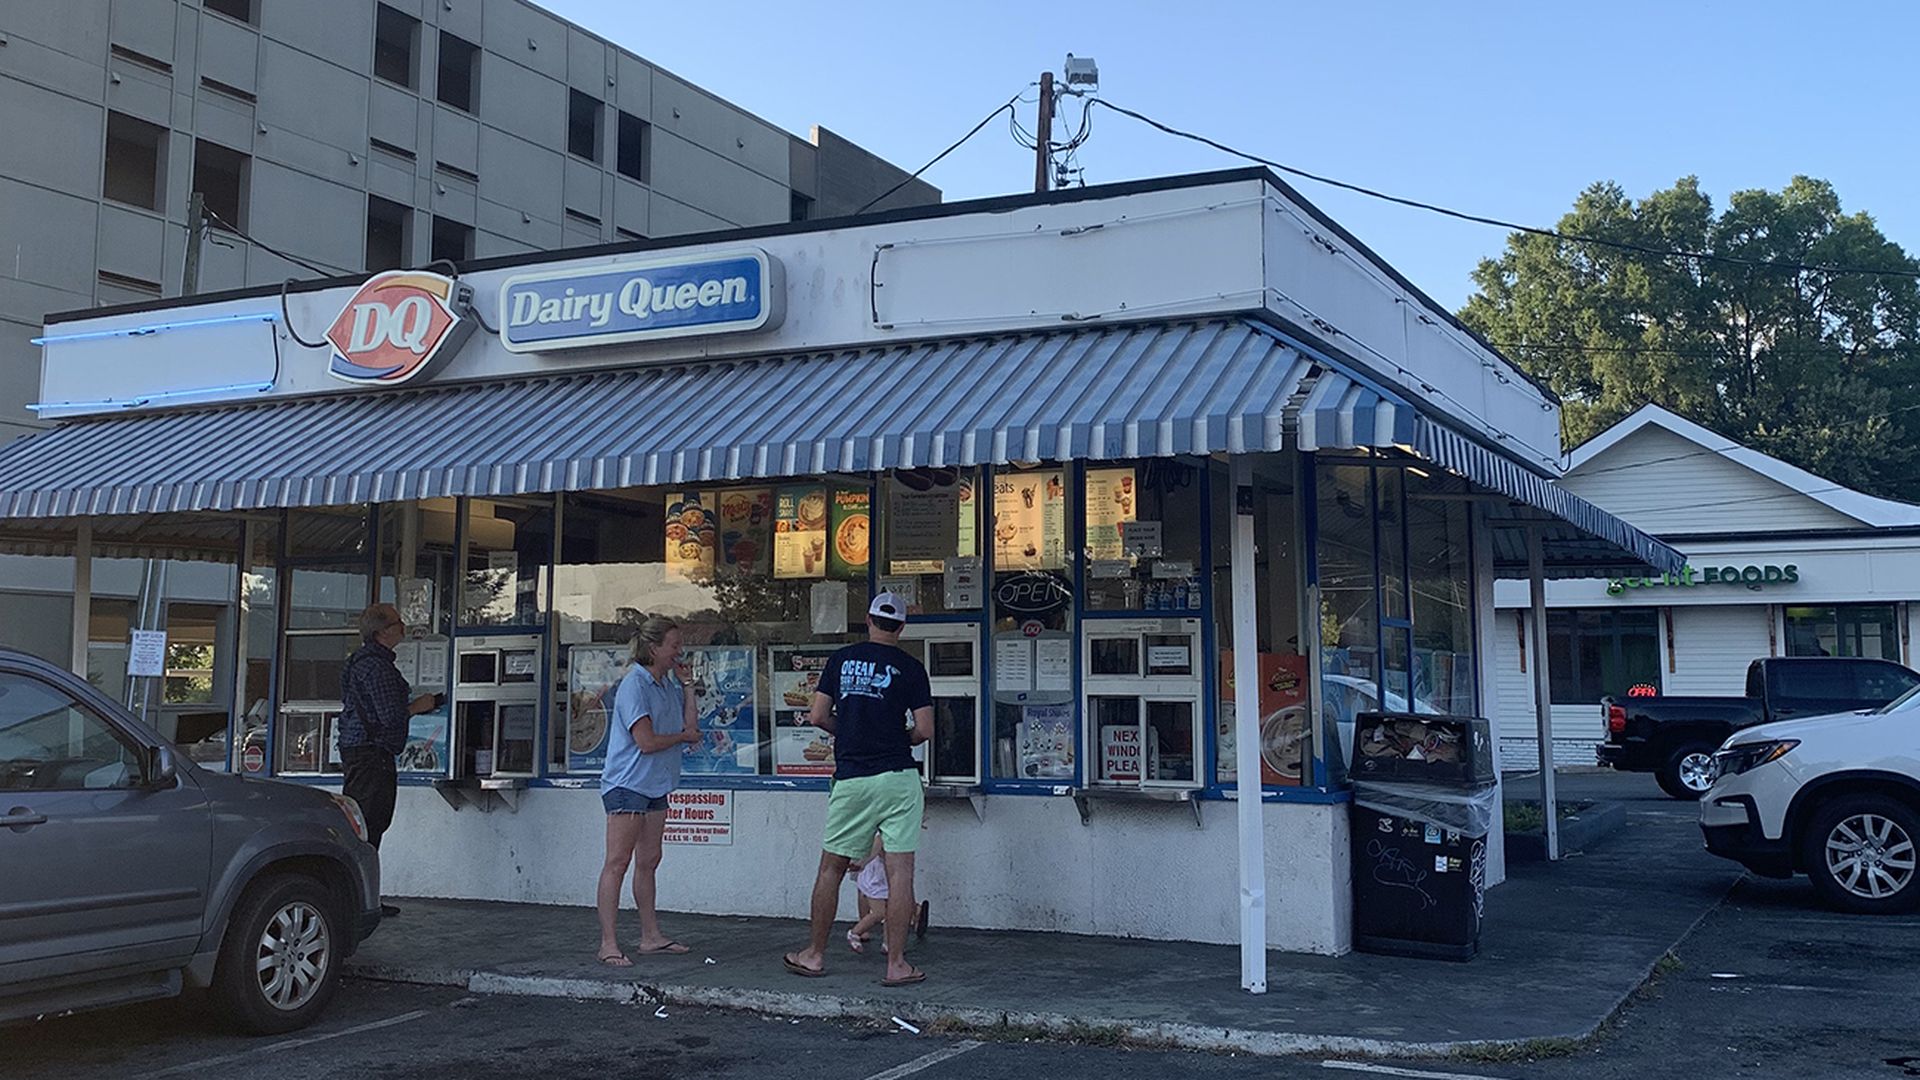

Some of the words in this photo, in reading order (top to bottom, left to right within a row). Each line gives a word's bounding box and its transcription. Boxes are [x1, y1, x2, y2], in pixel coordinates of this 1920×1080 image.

[510, 288, 613, 327] Dairy
[619, 276, 747, 319] Queen
[348, 296, 432, 354] DQ
[1704, 564, 1800, 585] FOODS
[998, 582, 1063, 603] OPEN
[841, 660, 876, 677] OCEAN
[1628, 686, 1657, 697] OPEN
[1113, 730, 1139, 742] NEX
[1107, 745, 1153, 757] WIND
[1107, 760, 1155, 771] PLEAE
[669, 791, 725, 806] respassing
[665, 808, 683, 820] fter
[684, 807, 715, 820] Hours
